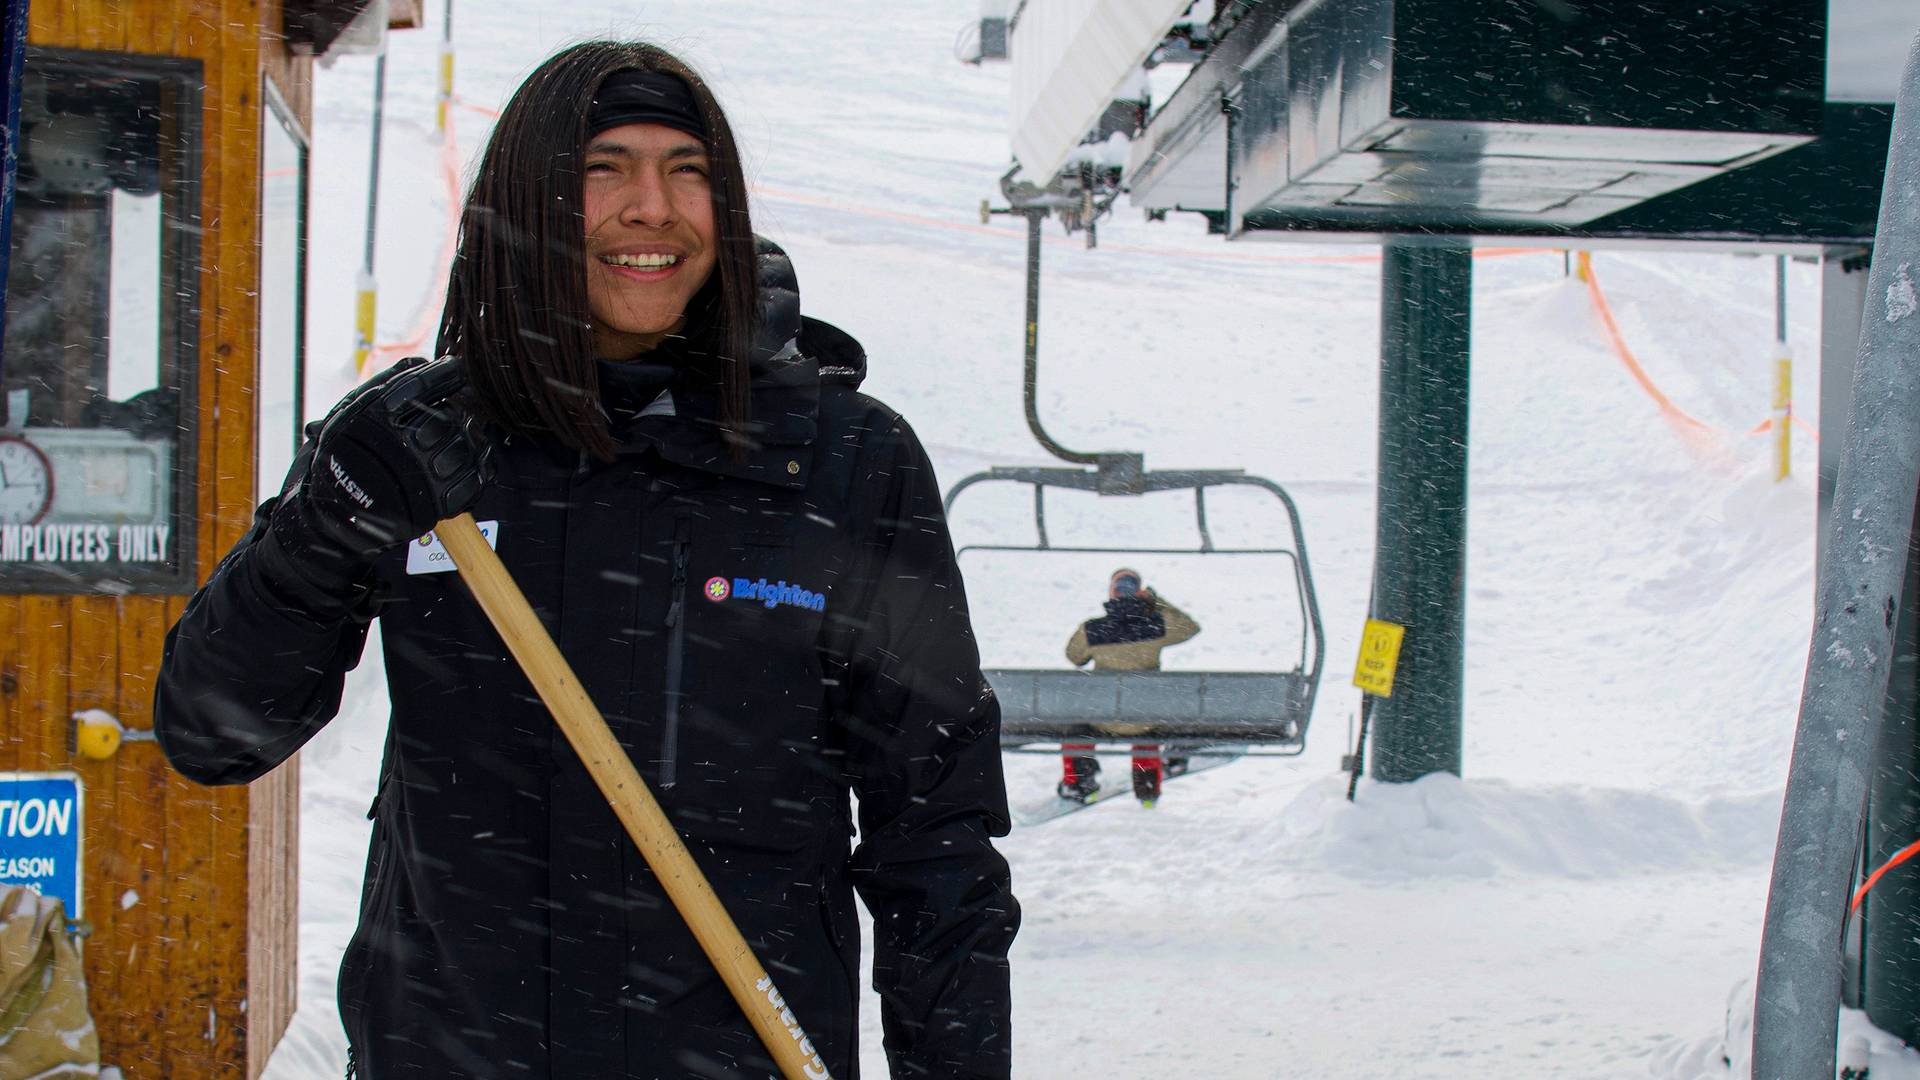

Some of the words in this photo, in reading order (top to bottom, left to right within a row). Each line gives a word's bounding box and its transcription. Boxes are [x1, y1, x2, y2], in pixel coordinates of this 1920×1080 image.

[330, 454, 374, 509] HESTRA
[0, 524, 110, 561] MPLOYEES
[118, 524, 169, 561] ONLY
[733, 578, 825, 612] Brighton
[756, 973, 830, 1080] Garant
